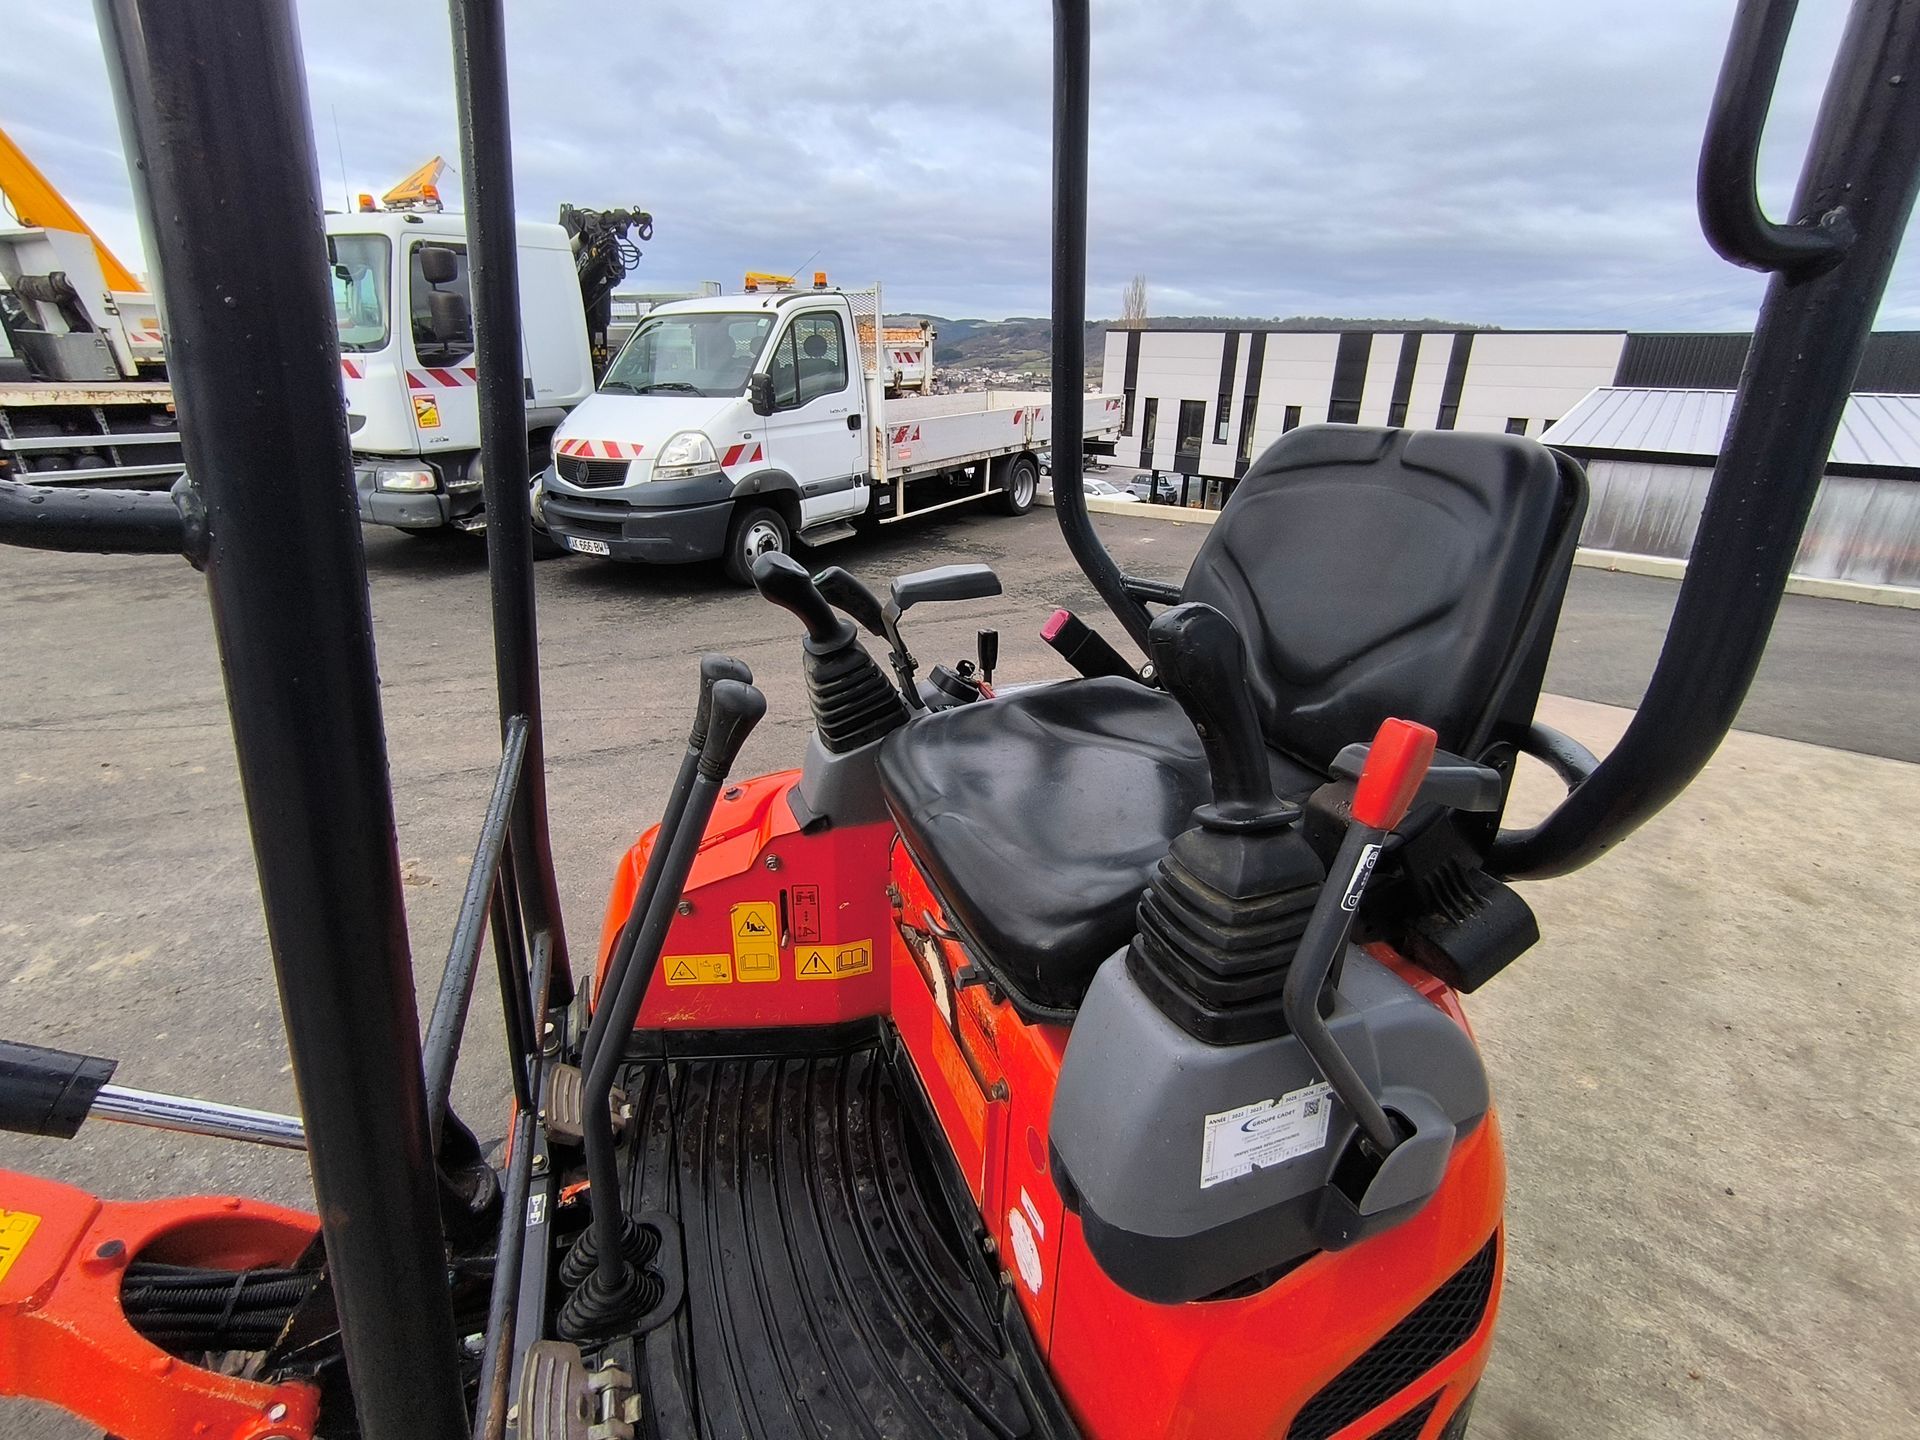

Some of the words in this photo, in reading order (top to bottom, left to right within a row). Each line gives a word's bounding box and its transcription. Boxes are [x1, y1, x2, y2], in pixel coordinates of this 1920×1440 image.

[1209, 1117, 1226, 1125] ANNÉE
[1252, 1116, 1276, 1127] GROUPE
[1277, 1109, 1295, 1119] CADET
